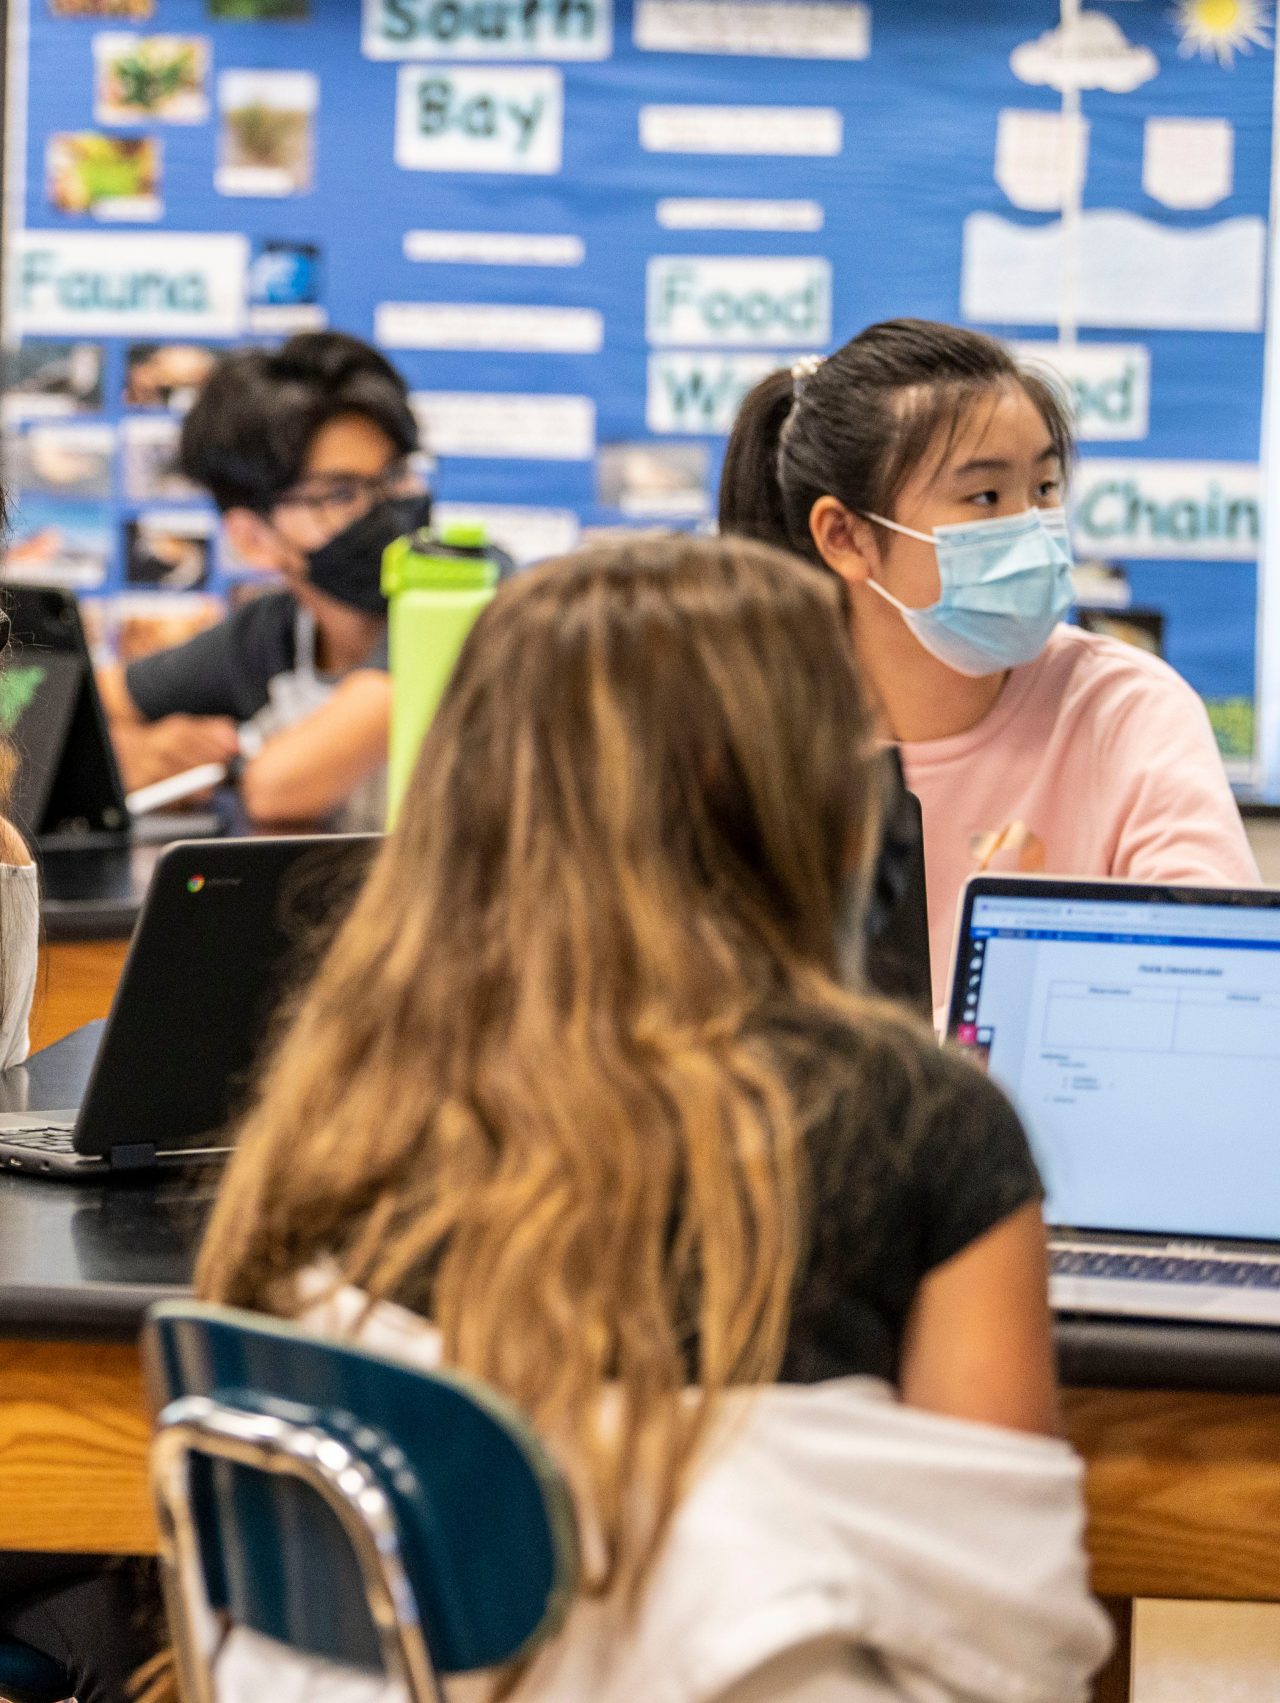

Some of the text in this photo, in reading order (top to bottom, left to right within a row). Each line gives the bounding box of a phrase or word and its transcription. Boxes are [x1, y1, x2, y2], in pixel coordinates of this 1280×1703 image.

[380, 0, 598, 42] South
[418, 79, 543, 153] Bay
[19, 249, 207, 311] Fauna
[661, 266, 817, 330] Food
[1079, 478, 1261, 541] Chain
